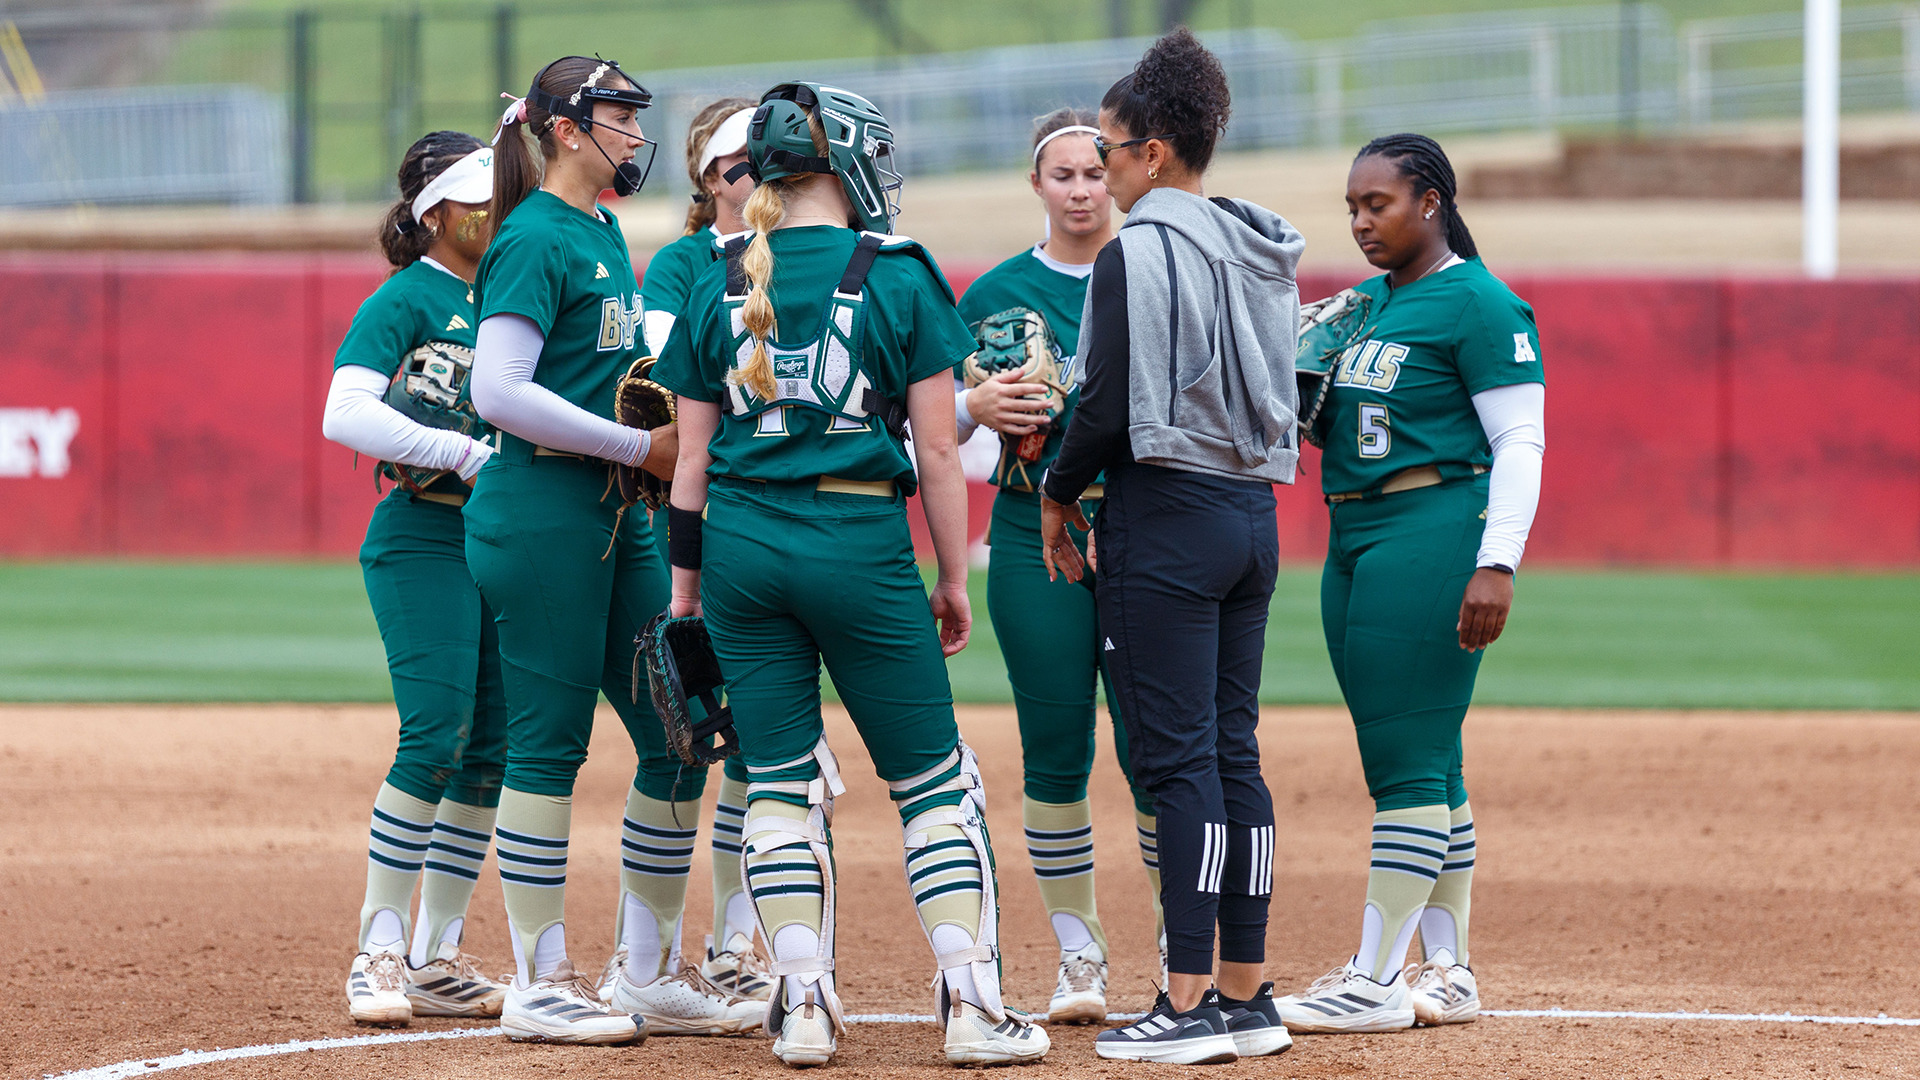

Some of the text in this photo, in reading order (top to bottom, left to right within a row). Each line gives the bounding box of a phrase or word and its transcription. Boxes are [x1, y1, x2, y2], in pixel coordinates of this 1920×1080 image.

[1333, 339, 1410, 393] LLS
[1513, 332, 1536, 363] A
[1357, 402, 1392, 459] 5
